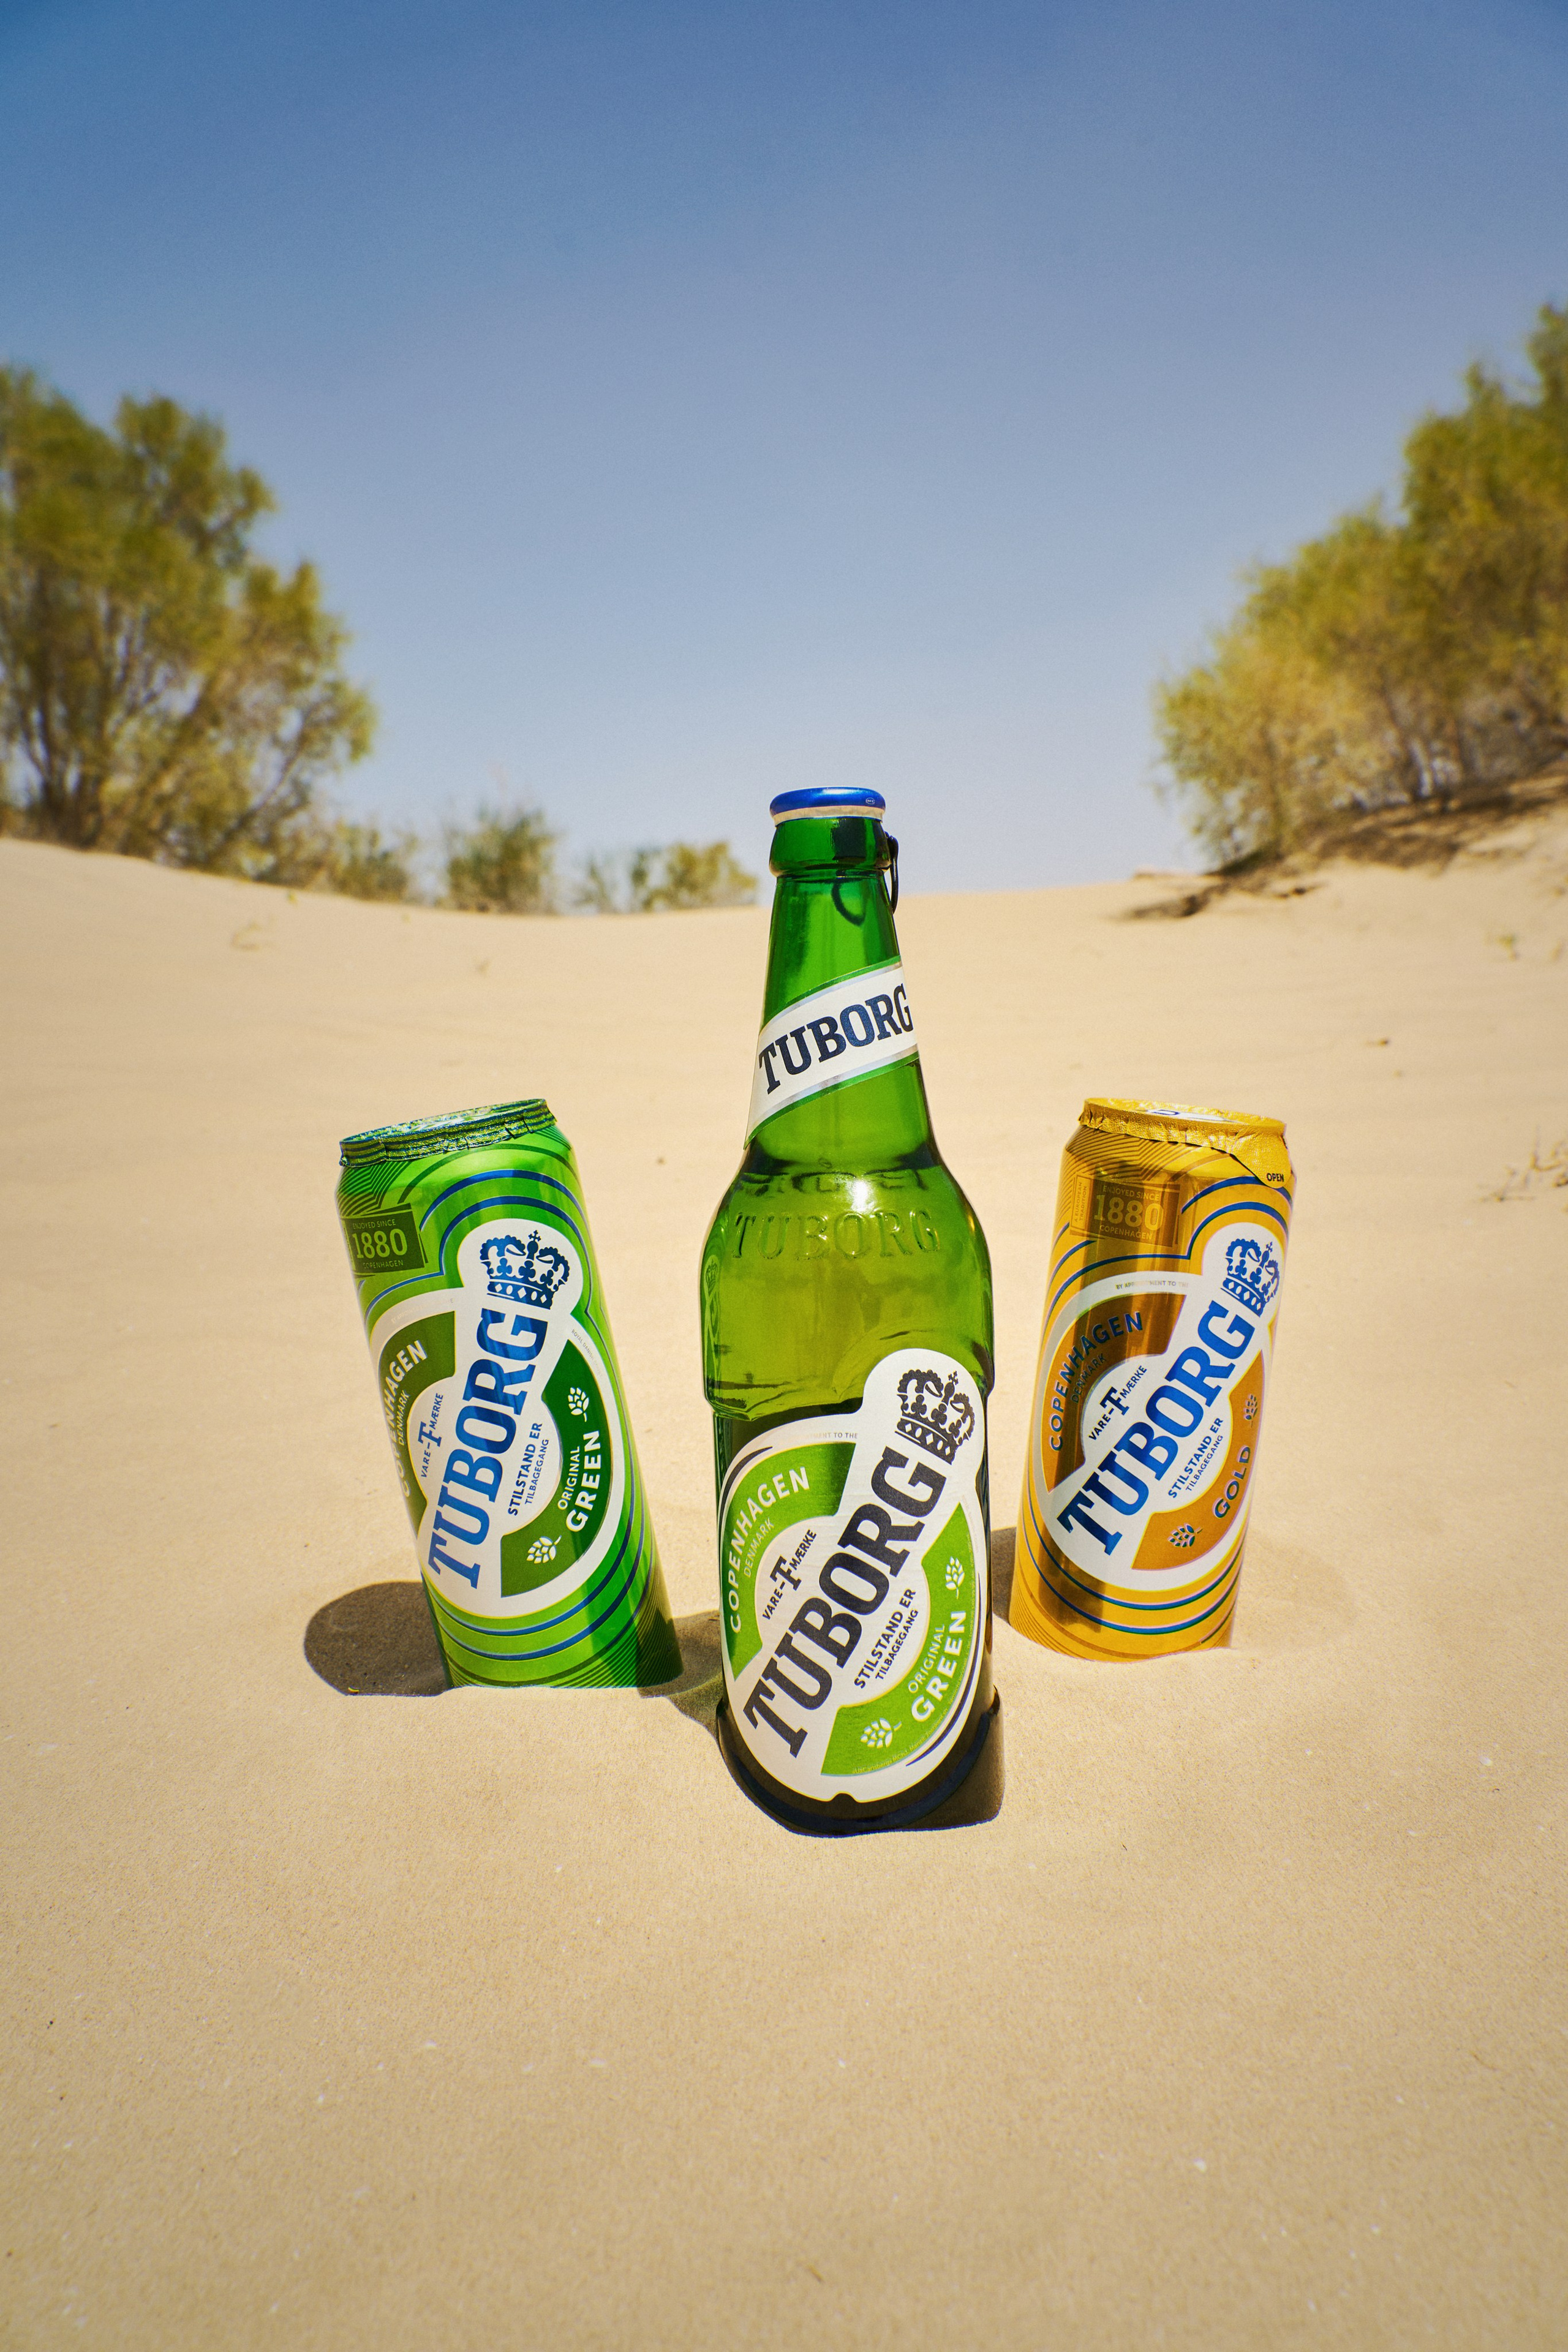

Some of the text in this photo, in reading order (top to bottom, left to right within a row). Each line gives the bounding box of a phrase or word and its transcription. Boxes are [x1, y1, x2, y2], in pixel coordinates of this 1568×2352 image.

[758, 982, 913, 1095] TUBORG
[1103, 1185, 1160, 1201] ENJOYED SINCE
[1266, 1172, 1284, 1182] OPEN
[352, 1228, 407, 1259] 1880
[377, 1219, 396, 1227] SINCE
[731, 1210, 940, 1260] TUBORG
[1094, 1195, 1164, 1231] 1880
[1099, 1225, 1153, 1240] COPENHAGEN
[363, 1260, 404, 1268] COPENHAGEN
[571, 1329, 583, 1343] ROYAL
[1049, 1311, 1143, 1452] COPENHAGEN
[1071, 1353, 1106, 1404] DENMARK
[384, 1340, 428, 1497] COPENHAGEN
[398, 1390, 410, 1446] DENMARK
[428, 1307, 548, 1589] TUBORG
[1056, 1300, 1256, 1556] TUBORG
[508, 1423, 543, 1516] STILSTAND ER
[525, 1439, 549, 1505] TILBAGEGANG
[557, 1446, 580, 1510] ORIGINAL
[566, 1430, 601, 1532] GREEN
[1168, 1417, 1223, 1498] STILSTAND ER
[1186, 1434, 1223, 1491] TILBAGEGANG
[1213, 1446, 1251, 1518] GOLD
[728, 1466, 810, 1634] COPENHAGEN
[744, 1517, 774, 1578] DENMARK
[743, 1446, 947, 1758] TUBORG
[854, 1589, 916, 1689] STILSTAND ER
[875, 1608, 919, 1680] TILBAGEGANG
[908, 1624, 945, 1694] ORIGINAL
[911, 1611, 967, 1722] GREEN
